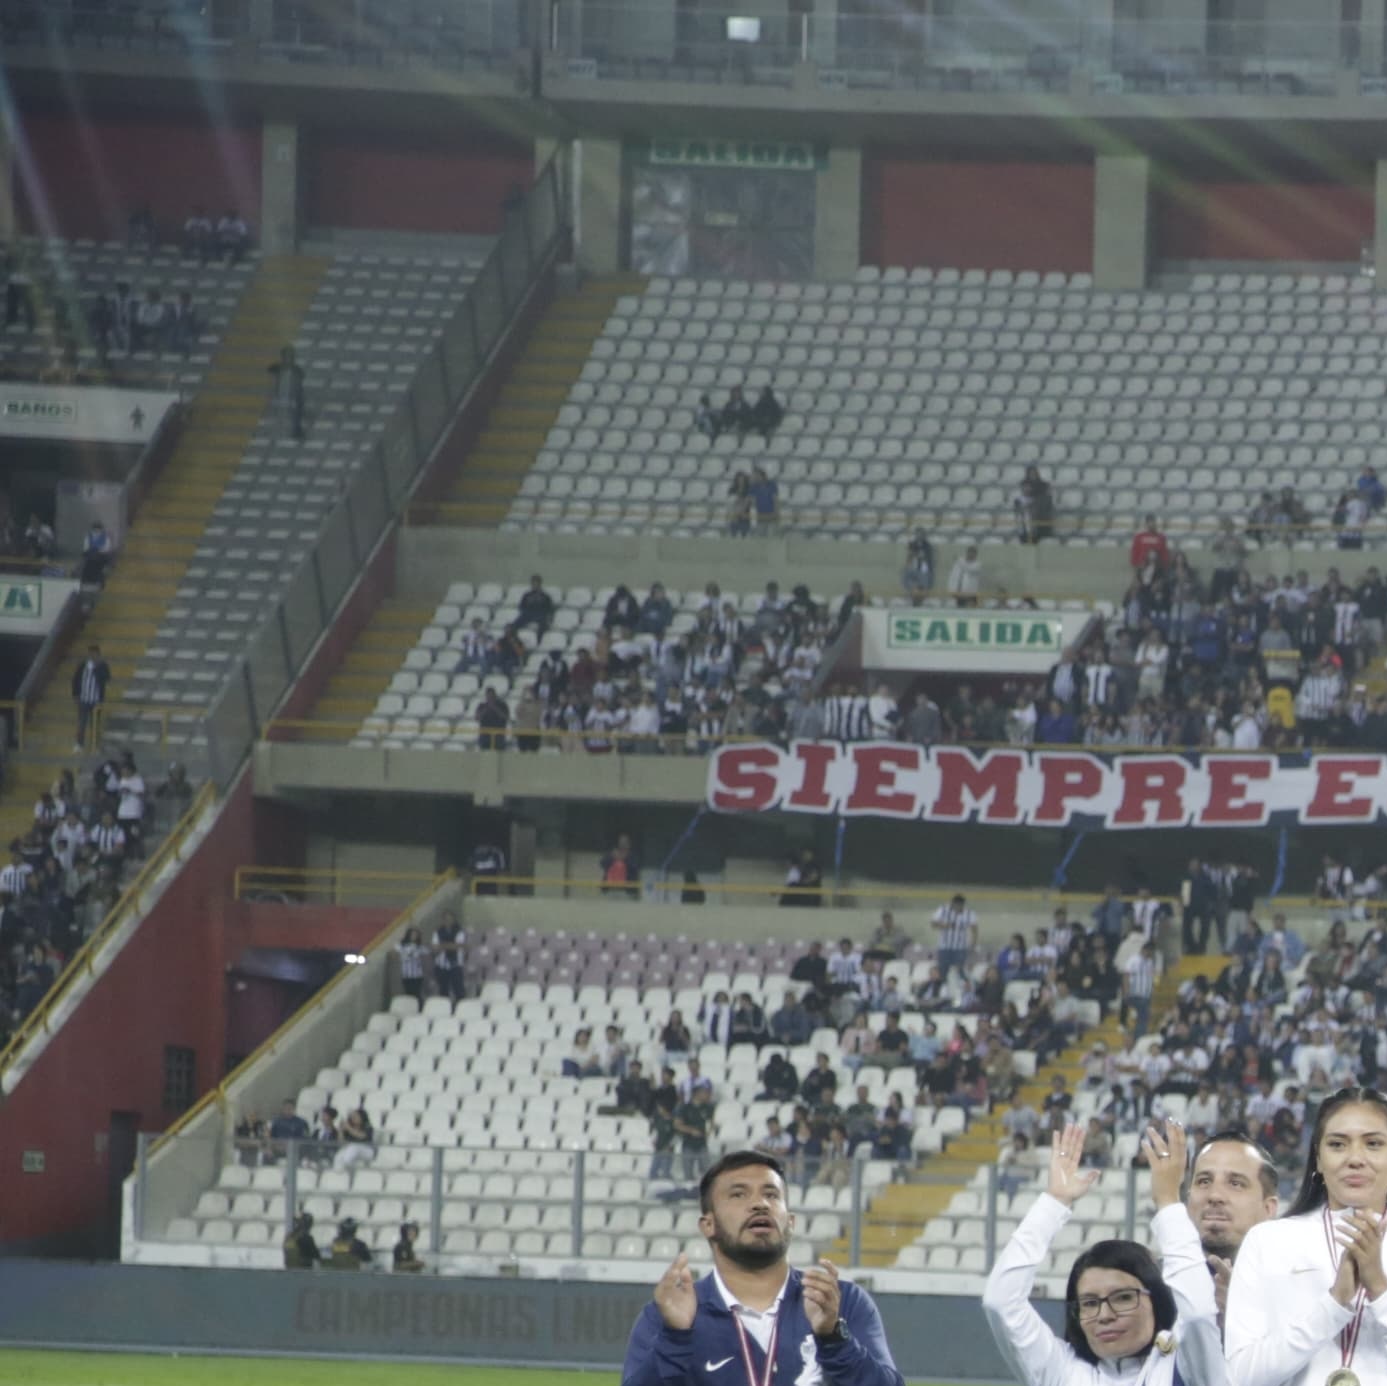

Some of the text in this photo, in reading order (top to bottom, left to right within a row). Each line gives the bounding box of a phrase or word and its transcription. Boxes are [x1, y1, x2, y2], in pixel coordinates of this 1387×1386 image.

[894, 618, 1057, 647] SALIDA
[711, 745, 1273, 826] SIEMPRE
[294, 1286, 538, 1342] CAMPEONAS
